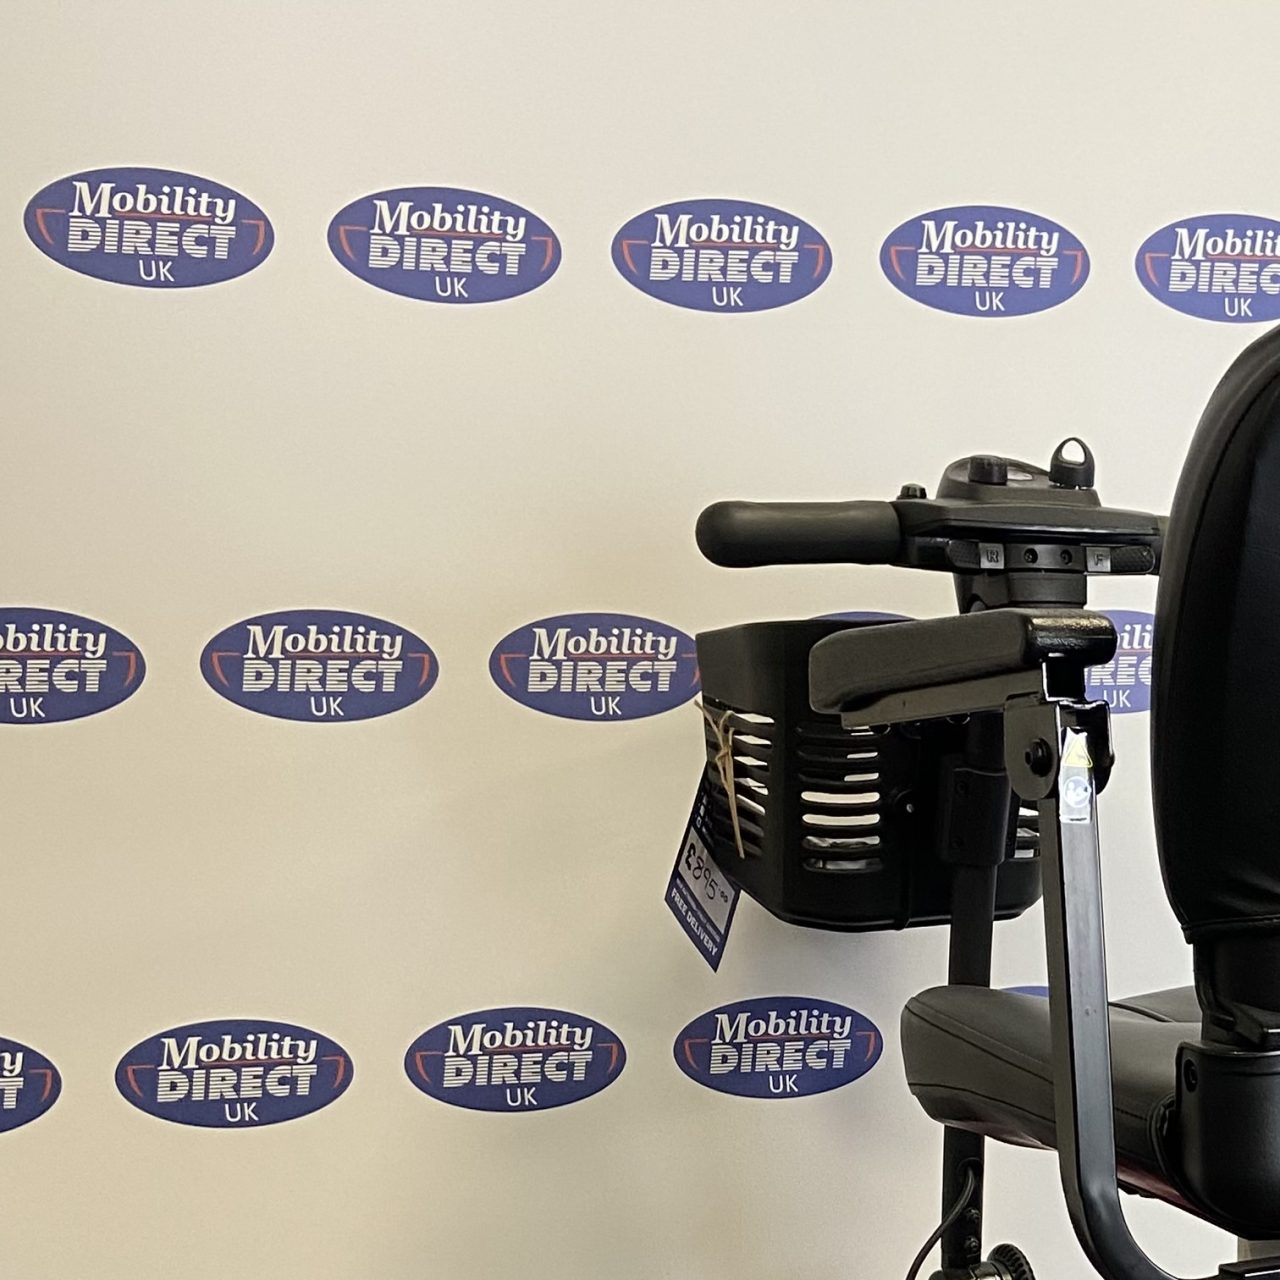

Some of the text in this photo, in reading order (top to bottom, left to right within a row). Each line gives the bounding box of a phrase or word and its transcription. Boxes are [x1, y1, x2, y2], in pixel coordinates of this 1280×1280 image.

[68, 181, 236, 225] Mobility
[370, 200, 527, 241] Mobility
[651, 214, 800, 250] Mobility
[67, 218, 237, 259] DIRECT
[368, 235, 527, 275] DIRECT
[917, 220, 1060, 256] Mobility
[139, 259, 175, 281] UK
[649, 249, 800, 284] DIRECT
[915, 254, 1059, 289] DIRECT
[435, 276, 468, 298] UK
[711, 286, 744, 306] UK
[975, 291, 1006, 311] UK
[1224, 297, 1253, 317] UK
[0, 623, 107, 659] bility
[243, 625, 403, 659] Mobility
[529, 627, 678, 660] Mobility
[0, 659, 108, 693] RECT
[242, 659, 403, 692] DIRECT
[527, 661, 677, 692] DIRECT
[10, 697, 46, 718] UK
[310, 696, 345, 716] UK
[590, 696, 622, 715] UK
[1103, 689, 1133, 708] UK
[671, 887, 688, 916] FREE
[686, 911, 719, 956] DELIVERY
[444, 1021, 593, 1056] Mobility
[711, 1009, 852, 1043] Mobility
[157, 1033, 318, 1070] Mobility
[710, 1040, 852, 1075] DIRECT
[157, 1064, 318, 1103] DIRECT
[443, 1051, 593, 1088] DIRECT
[769, 1074, 799, 1093] UK
[225, 1102, 259, 1122] UK
[506, 1087, 538, 1106] UK
